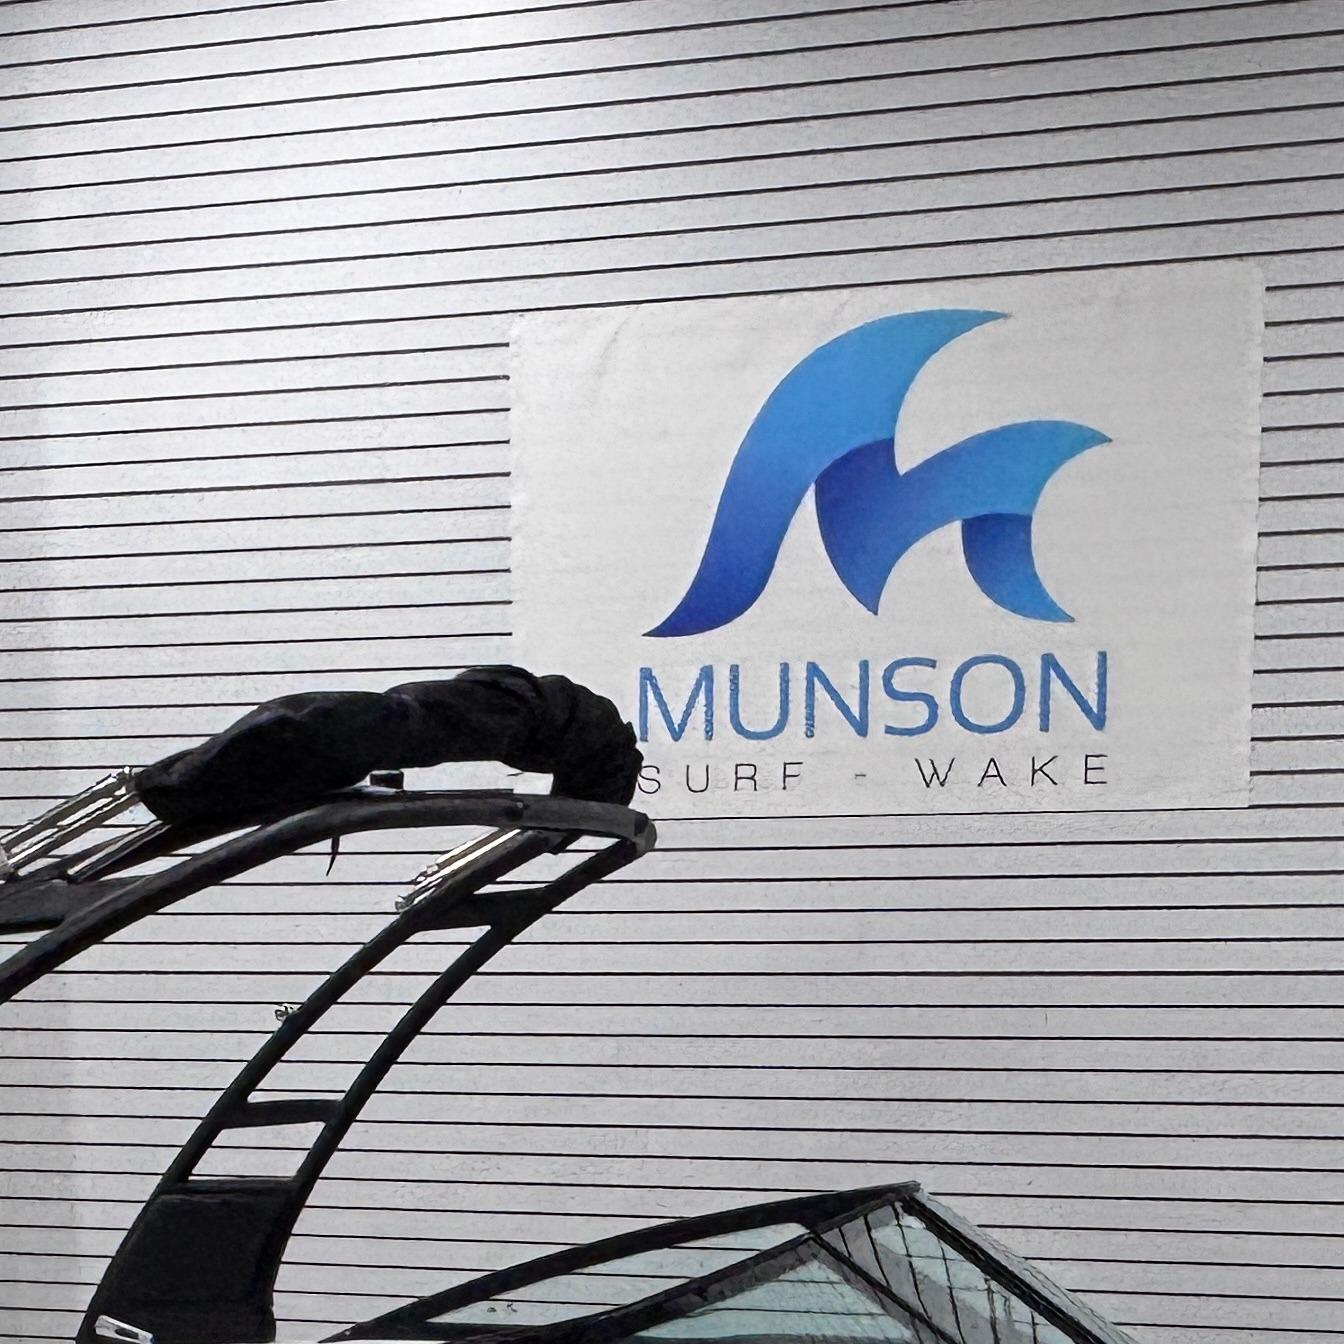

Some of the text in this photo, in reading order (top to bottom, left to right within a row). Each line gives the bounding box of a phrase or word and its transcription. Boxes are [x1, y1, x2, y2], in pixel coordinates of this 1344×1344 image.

[637, 650, 1109, 742] MUNSON
[637, 761, 804, 795] SURF
[914, 753, 1109, 789] WAKE
